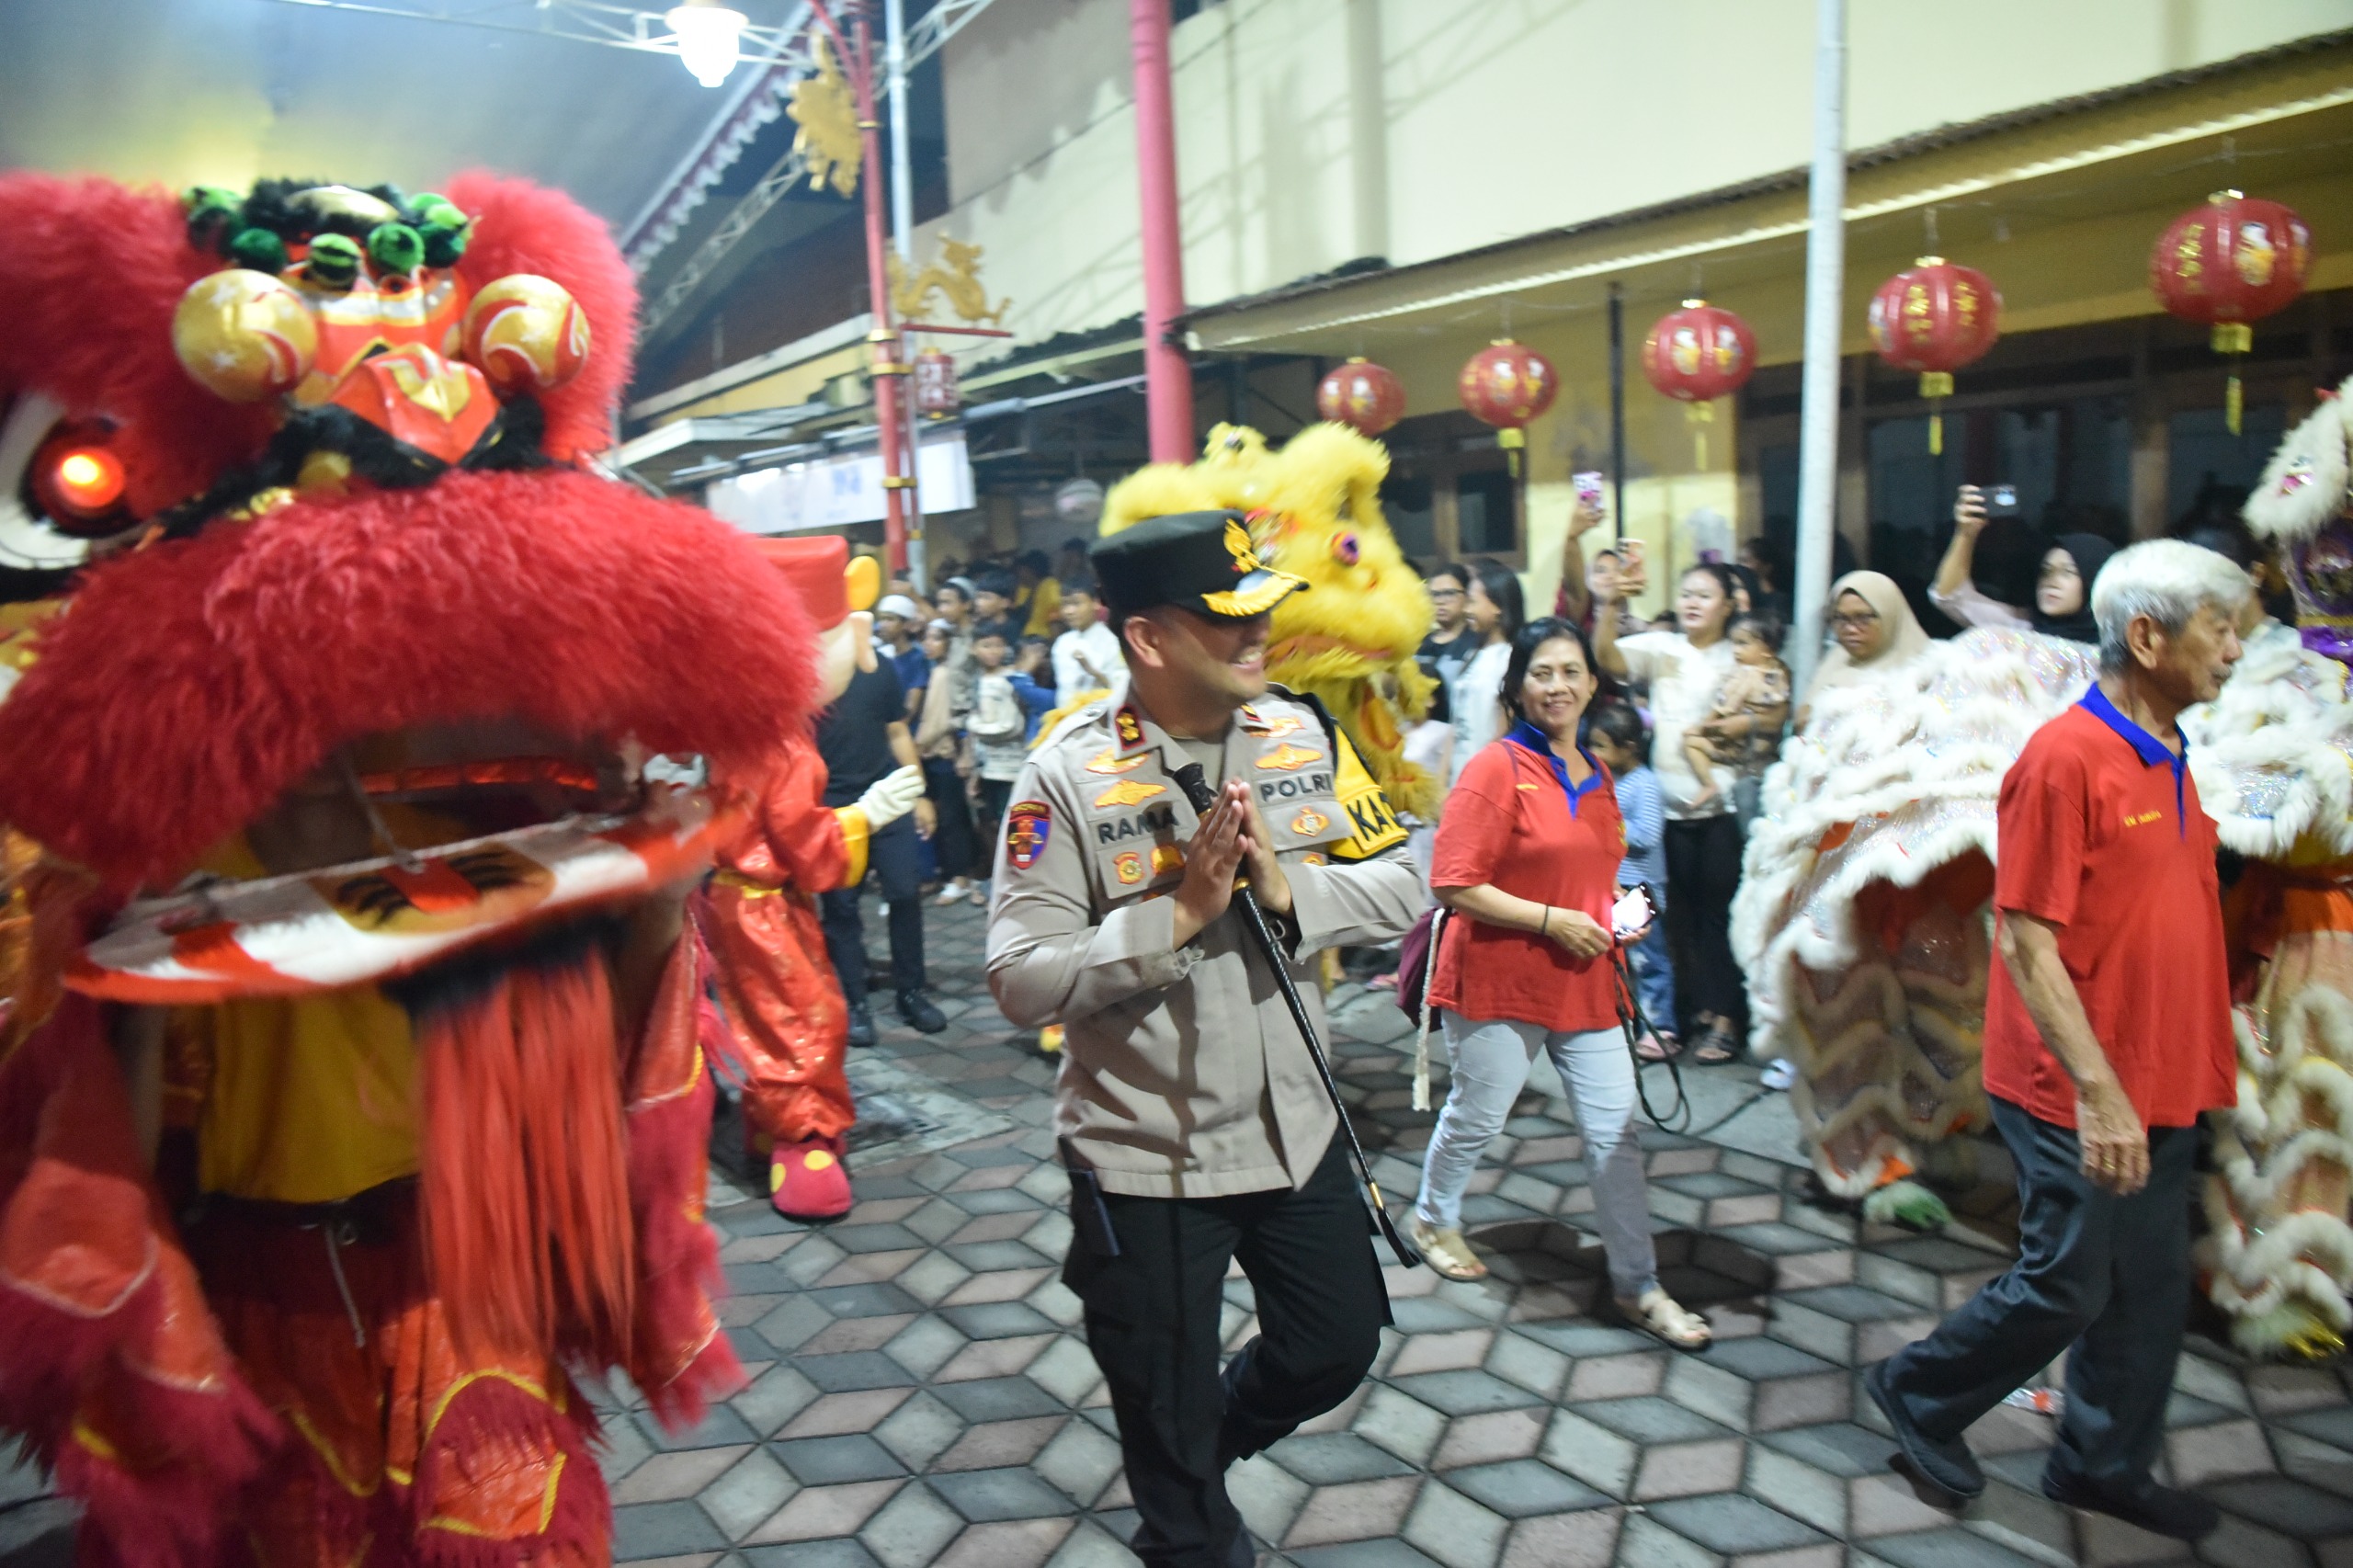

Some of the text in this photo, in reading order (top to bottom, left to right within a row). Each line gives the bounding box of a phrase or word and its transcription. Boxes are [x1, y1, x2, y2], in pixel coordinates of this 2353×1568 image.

[1260, 773, 1332, 802] POLRI
[1097, 807, 1180, 845] RAMA
[1346, 791, 1400, 842] KA
